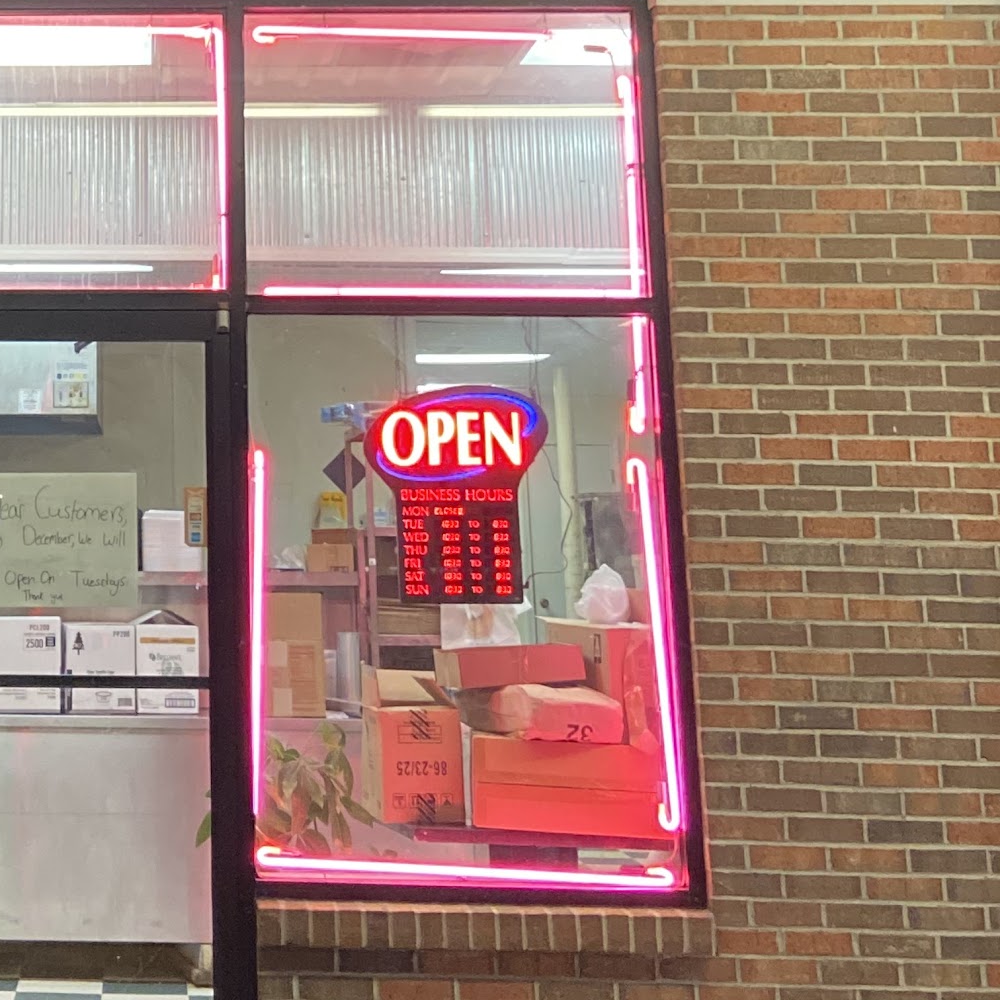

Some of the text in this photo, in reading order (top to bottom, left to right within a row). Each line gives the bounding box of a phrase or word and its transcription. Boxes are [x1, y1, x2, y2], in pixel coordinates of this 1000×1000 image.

[381, 410, 522, 467] OPEN
[400, 489, 513, 501] BUSINESS HOURS
[34, 485, 128, 528] Customers,
[402, 506, 430, 516] MON
[402, 519, 424, 529] TUE
[468, 520, 480, 529] TO
[22, 524, 75, 548] December,
[103, 531, 126, 546] Will
[402, 532, 429, 542] WED
[468, 533, 481, 541] TO
[403, 545, 428, 555] THU
[469, 546, 481, 554] TO
[404, 558, 422, 568] FRI
[470, 559, 482, 567] TO
[404, 571, 425, 581] SAT
[470, 572, 482, 581] TO
[4, 570, 35, 590] Open
[40, 570, 55, 585] On
[70, 570, 126, 596] Tuesdays
[23, 589, 43, 600] Thank
[405, 584, 430, 595] SUN
[471, 585, 484, 594] TO
[26, 638, 44, 648] 2500
[396, 760, 448, 776] 86-23/25
